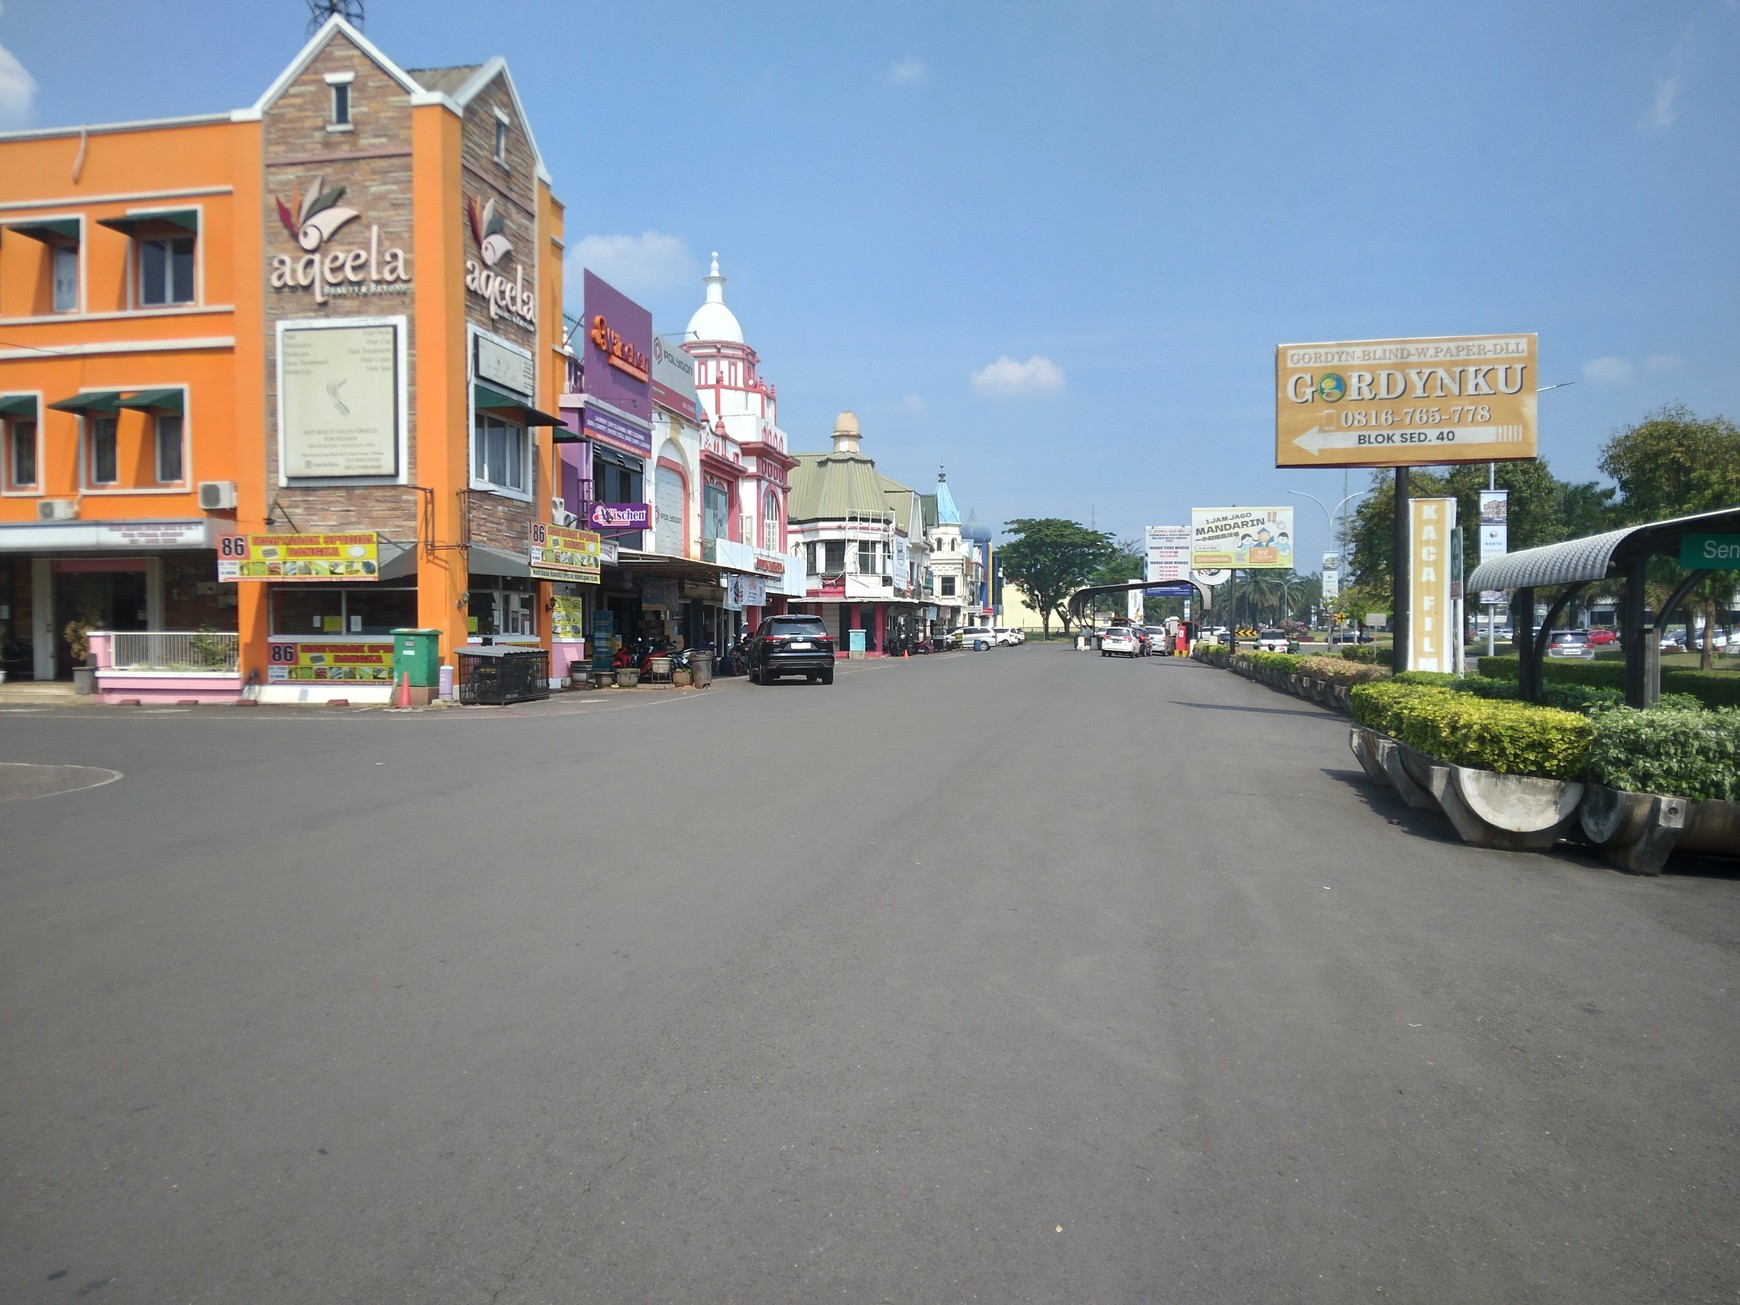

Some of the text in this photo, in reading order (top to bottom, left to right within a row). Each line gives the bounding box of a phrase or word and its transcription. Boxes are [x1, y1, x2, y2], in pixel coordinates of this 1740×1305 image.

[270, 225, 412, 304] aqeela
[465, 260, 536, 323] aqeela
[663, 350, 693, 377] POLYGON
[1290, 342, 1525, 365] GORDYN-BLIND-W.PAPER-DLL
[1341, 405, 1492, 428] 0816-765-778
[1358, 430, 1455, 445] BLOK SED. 40
[661, 512, 682, 524] POLYGON
[1195, 518, 1265, 536] MANDARIN
[1210, 516, 1229, 524] JAM
[1229, 512, 1252, 521] JAGO
[533, 524, 545, 543] 86
[222, 537, 245, 556] 86
[323, 534, 375, 545] SPECIAL
[1418, 504, 1438, 673] KACA FILM
[272, 645, 294, 662] 86
